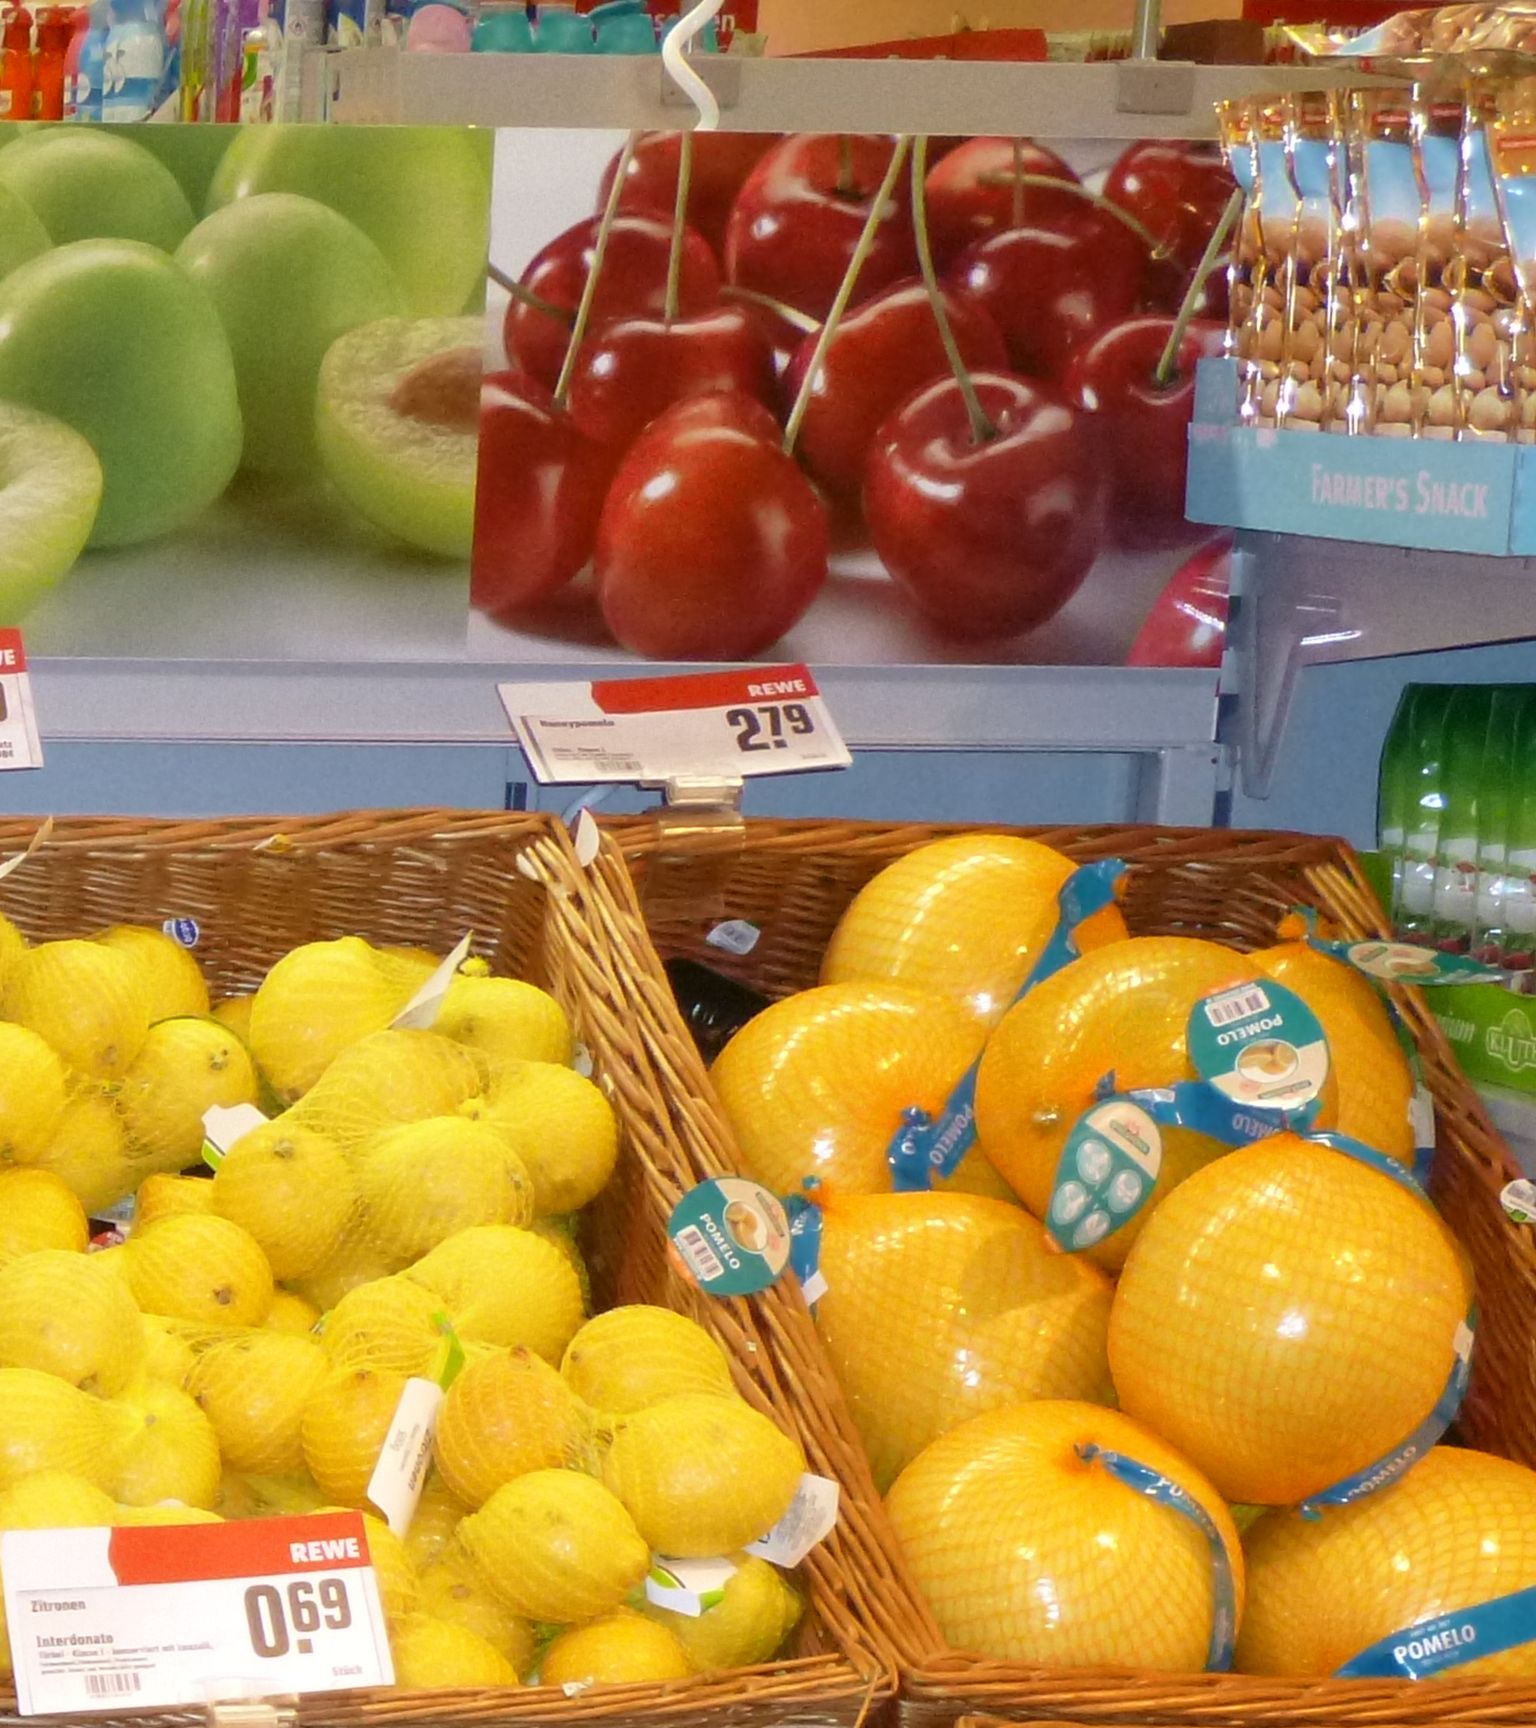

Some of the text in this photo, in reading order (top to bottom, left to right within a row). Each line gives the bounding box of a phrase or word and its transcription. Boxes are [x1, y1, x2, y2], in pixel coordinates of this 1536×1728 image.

[1310, 461, 1488, 518] FARMER'S SNACK
[746, 679, 807, 698] REWE
[725, 703, 815, 753] 2.79
[1216, 1013, 1284, 1047] POMELO
[930, 1104, 973, 1165] POMELO
[699, 1213, 741, 1270] POMELO
[289, 1537, 361, 1564] REWE
[29, 1598, 87, 1613] Zitronen
[243, 1577, 353, 1659] 0.69
[36, 1632, 115, 1649] Interdonato
[1393, 1624, 1477, 1664] POMELO
[331, 1664, 364, 1677] Stück
